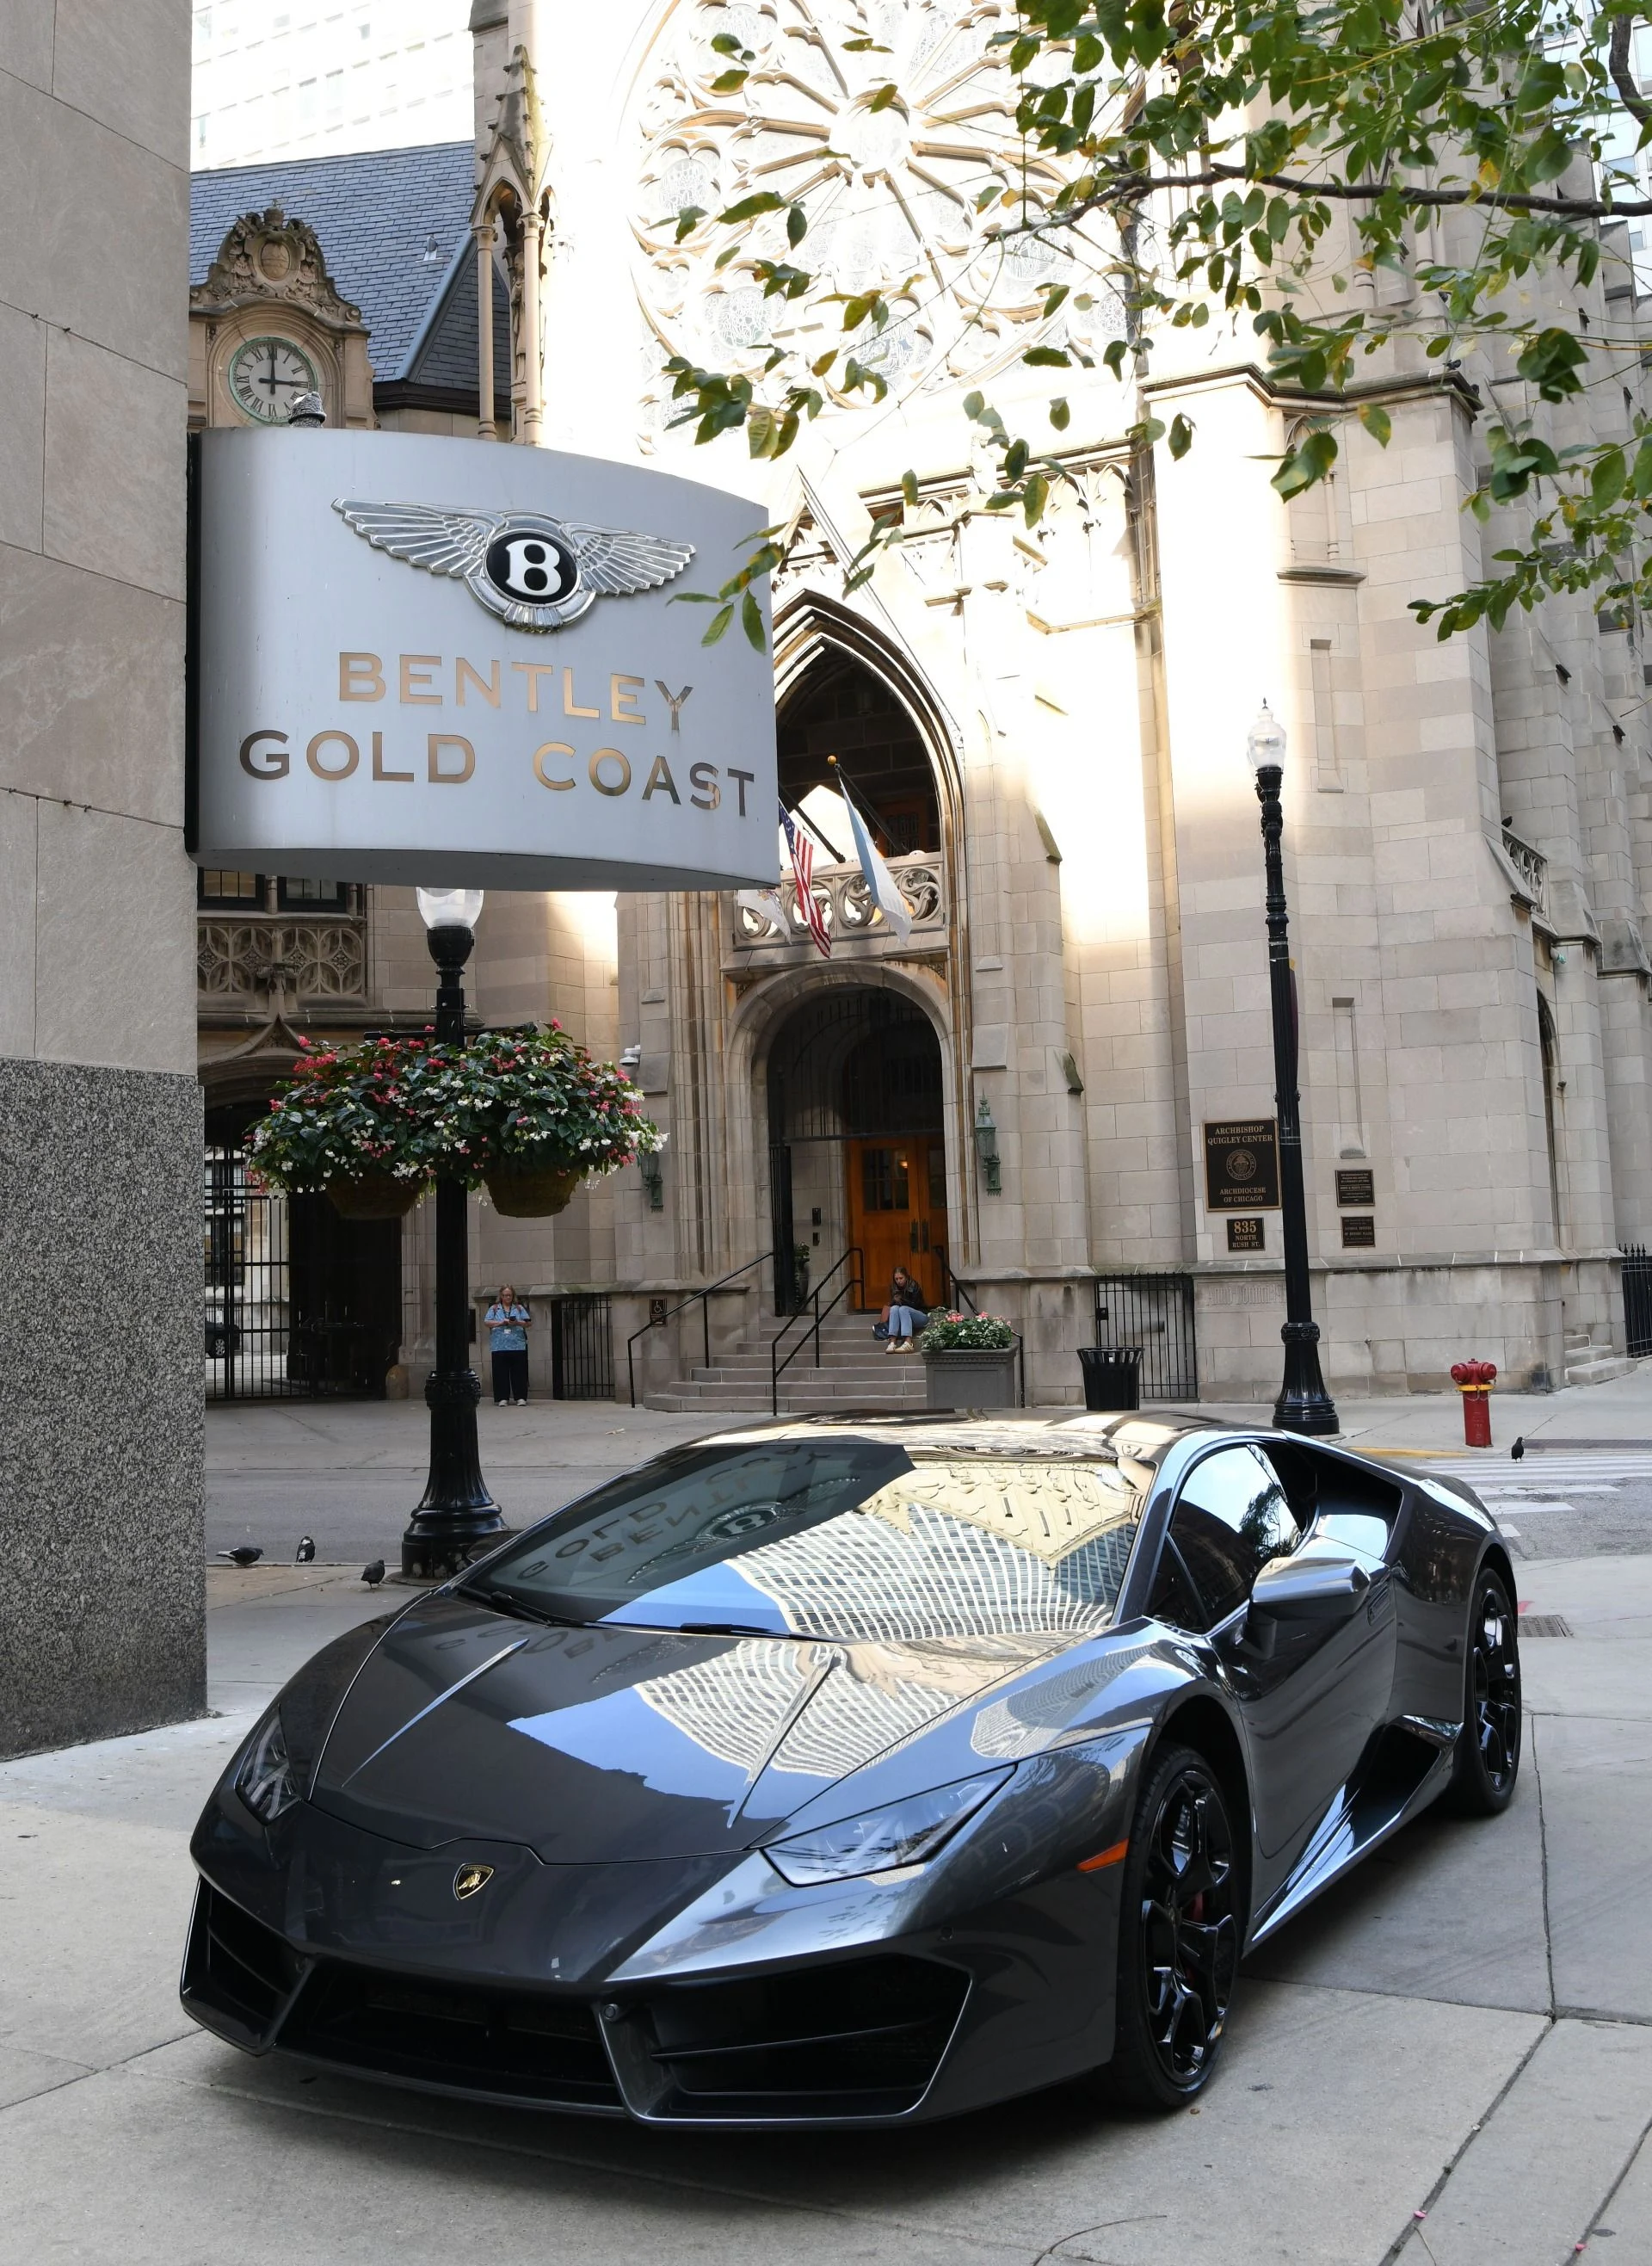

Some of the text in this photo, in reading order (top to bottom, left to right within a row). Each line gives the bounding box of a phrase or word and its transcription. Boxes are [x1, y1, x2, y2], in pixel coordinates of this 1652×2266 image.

[506, 540, 561, 596] B
[339, 651, 693, 732] BENTLEY
[238, 730, 755, 818] GOLD COAST
[1208, 1134, 1273, 1145] QUIGLEY CENTER
[1215, 1125, 1264, 1135] ARCHBISHOP
[1234, 1220, 1257, 1234] 835
